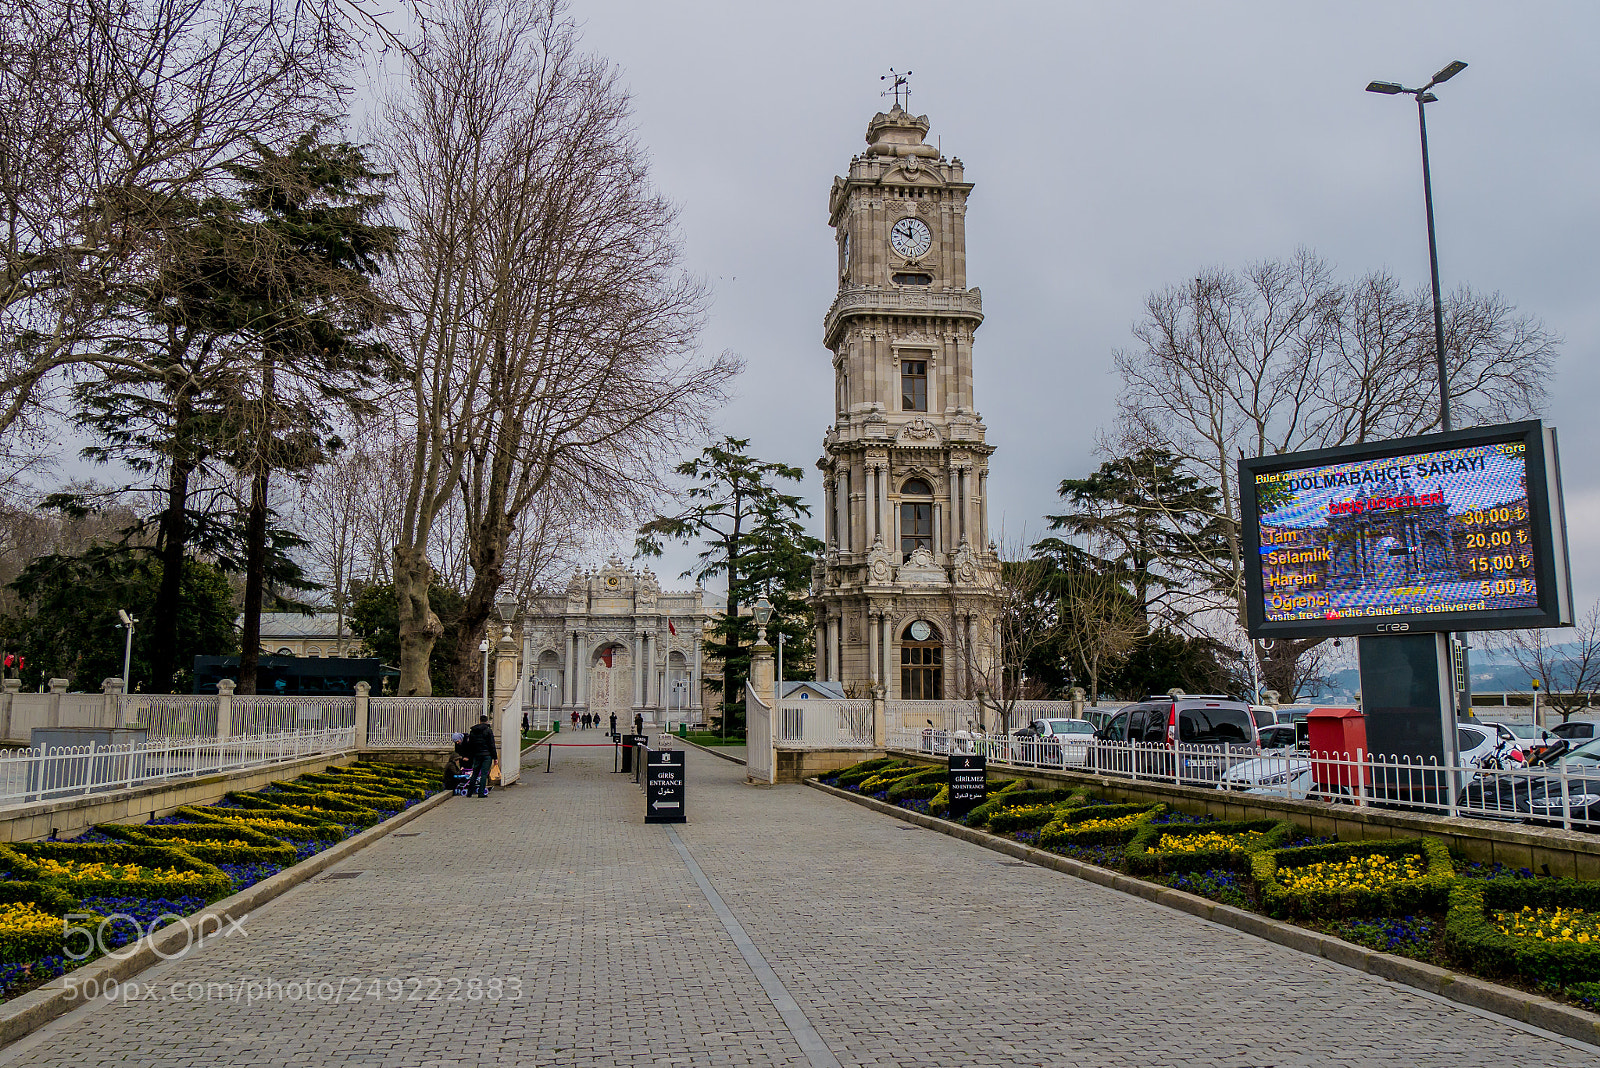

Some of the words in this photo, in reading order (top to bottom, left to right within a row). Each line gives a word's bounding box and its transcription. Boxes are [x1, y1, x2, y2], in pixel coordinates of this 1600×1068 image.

[1255, 472, 1280, 485] Bilet
[1287, 465, 1411, 493] DOLMABAHÇE
[1416, 456, 1485, 478] SARAYI
[1329, 500, 1364, 515] GİRİŞ
[1464, 507, 1510, 526] 30,00
[1266, 530, 1297, 543] Tam
[1466, 530, 1511, 549] 20,00
[1268, 547, 1332, 565] Selamlık
[1469, 555, 1515, 573] 15,00
[1269, 571, 1318, 587] Harem
[1481, 578, 1517, 598] 5,00
[1271, 591, 1331, 611] Öğrenci
[1267, 611, 1296, 622] visits
[1298, 610, 1321, 620] free
[1411, 604, 1421, 614] is
[1376, 622, 1410, 632] crea
[658, 771, 675, 779] GİRİŞ
